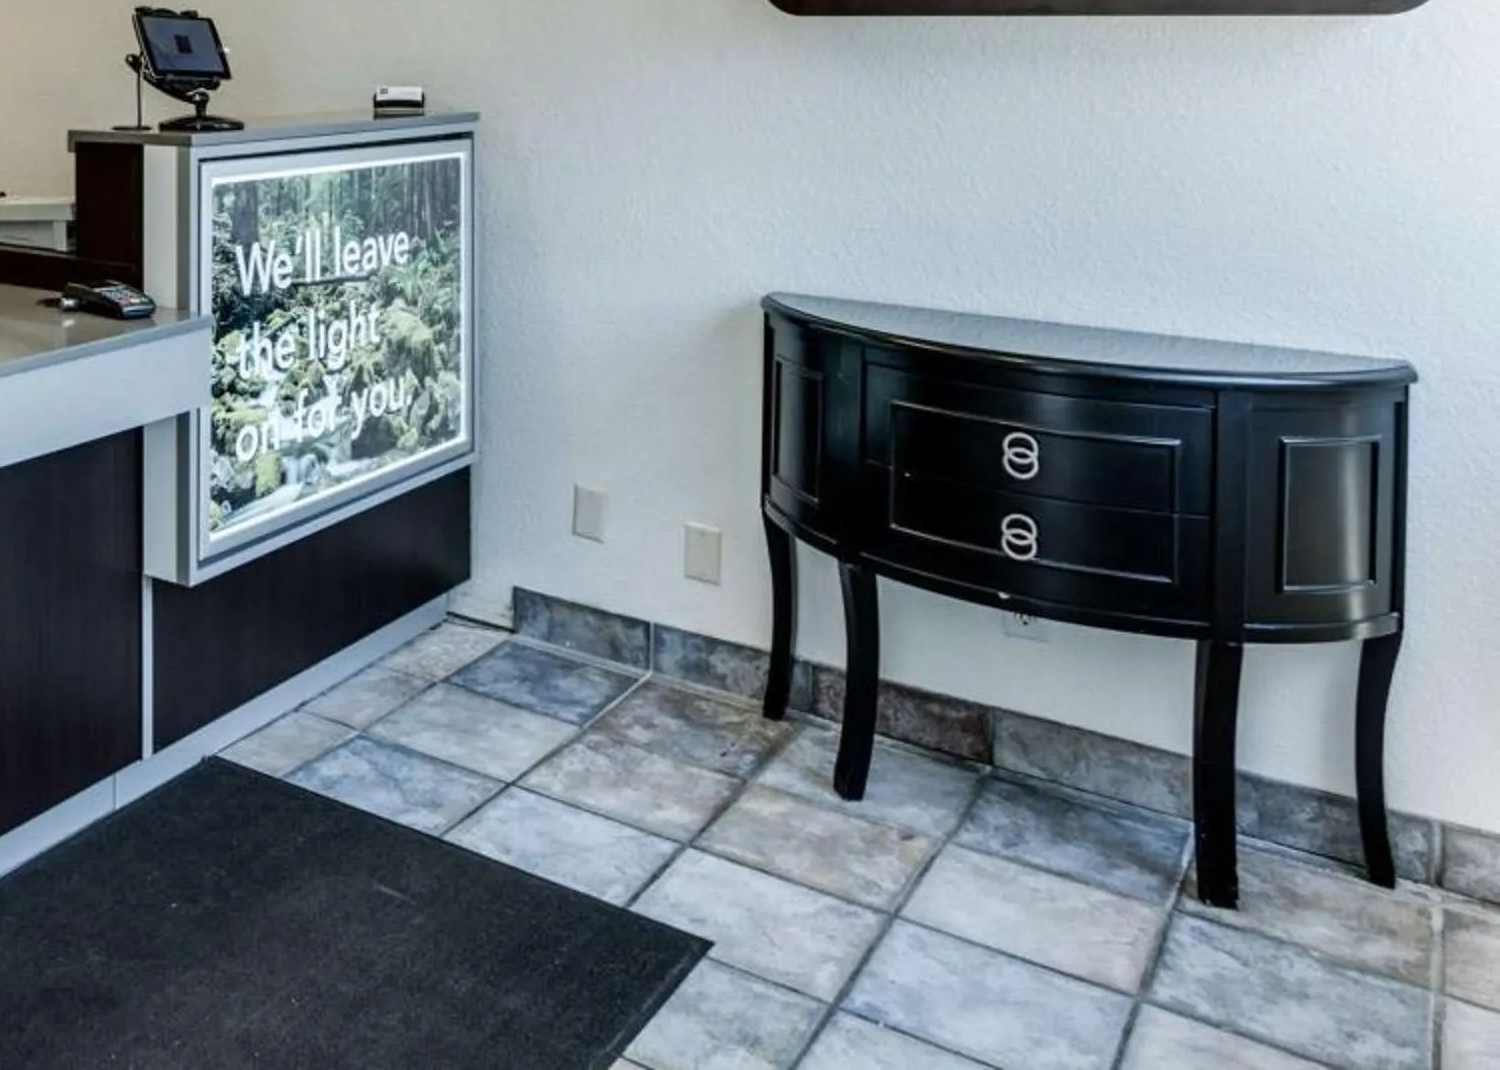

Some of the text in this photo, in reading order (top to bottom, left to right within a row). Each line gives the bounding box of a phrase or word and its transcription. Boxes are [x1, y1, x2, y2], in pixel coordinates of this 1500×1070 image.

[235, 225, 409, 296] We'll leave
[237, 299, 381, 380] the light
[236, 417, 280, 462] on
[294, 387, 343, 443] for
